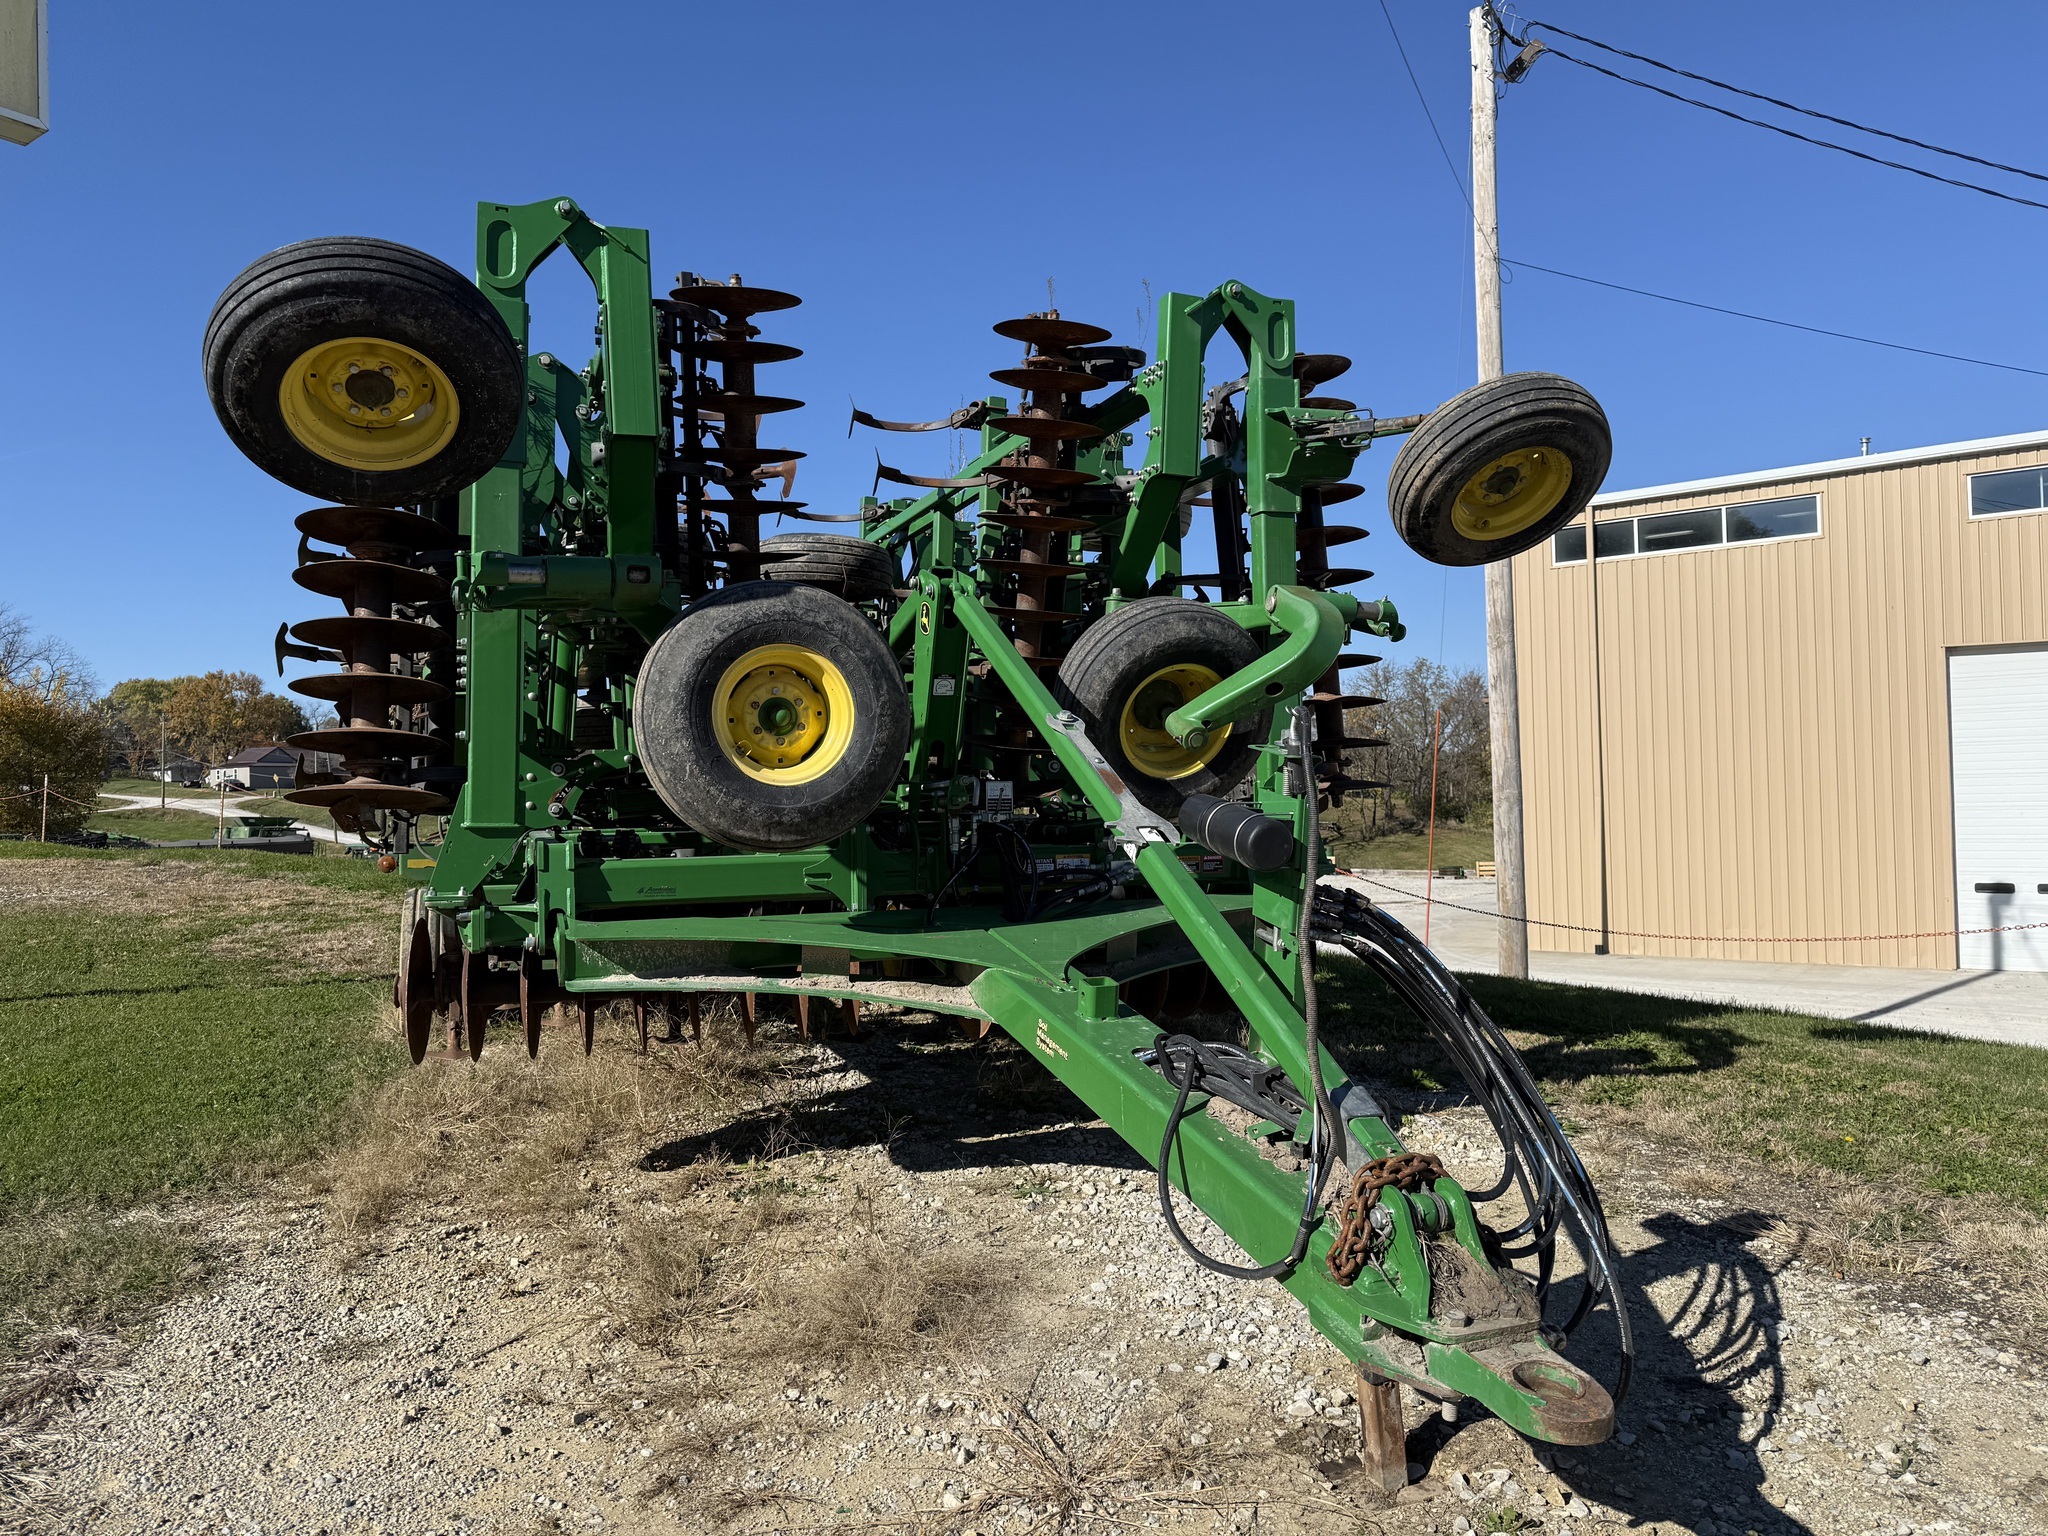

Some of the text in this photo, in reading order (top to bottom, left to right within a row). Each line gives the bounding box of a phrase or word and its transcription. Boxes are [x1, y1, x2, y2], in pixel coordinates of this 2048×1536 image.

[1038, 1018, 1048, 1032] Soil
[1036, 1037, 1055, 1058] System
[1037, 1027, 1069, 1061] Management
